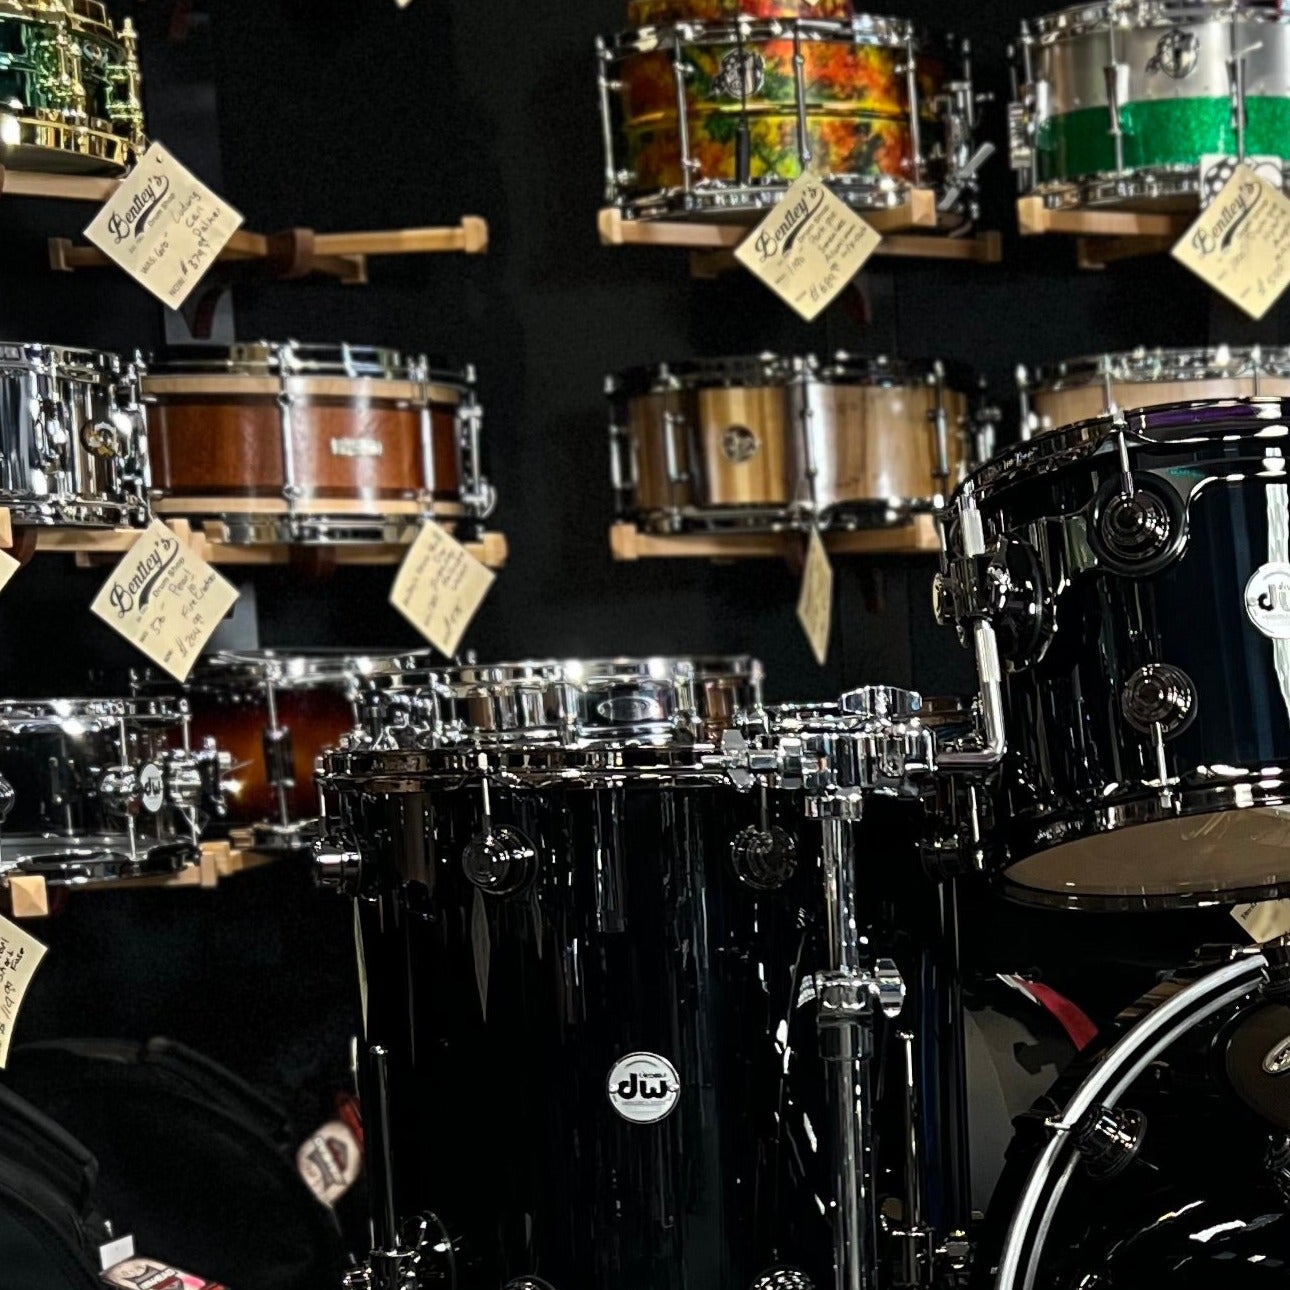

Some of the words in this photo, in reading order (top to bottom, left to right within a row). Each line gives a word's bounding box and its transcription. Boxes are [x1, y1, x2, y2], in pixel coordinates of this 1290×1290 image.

[107, 174, 168, 243] Bentley's
[755, 187, 823, 255] Bentley's
[108, 536, 177, 616] Bentley's
[618, 1072, 668, 1100] dw
